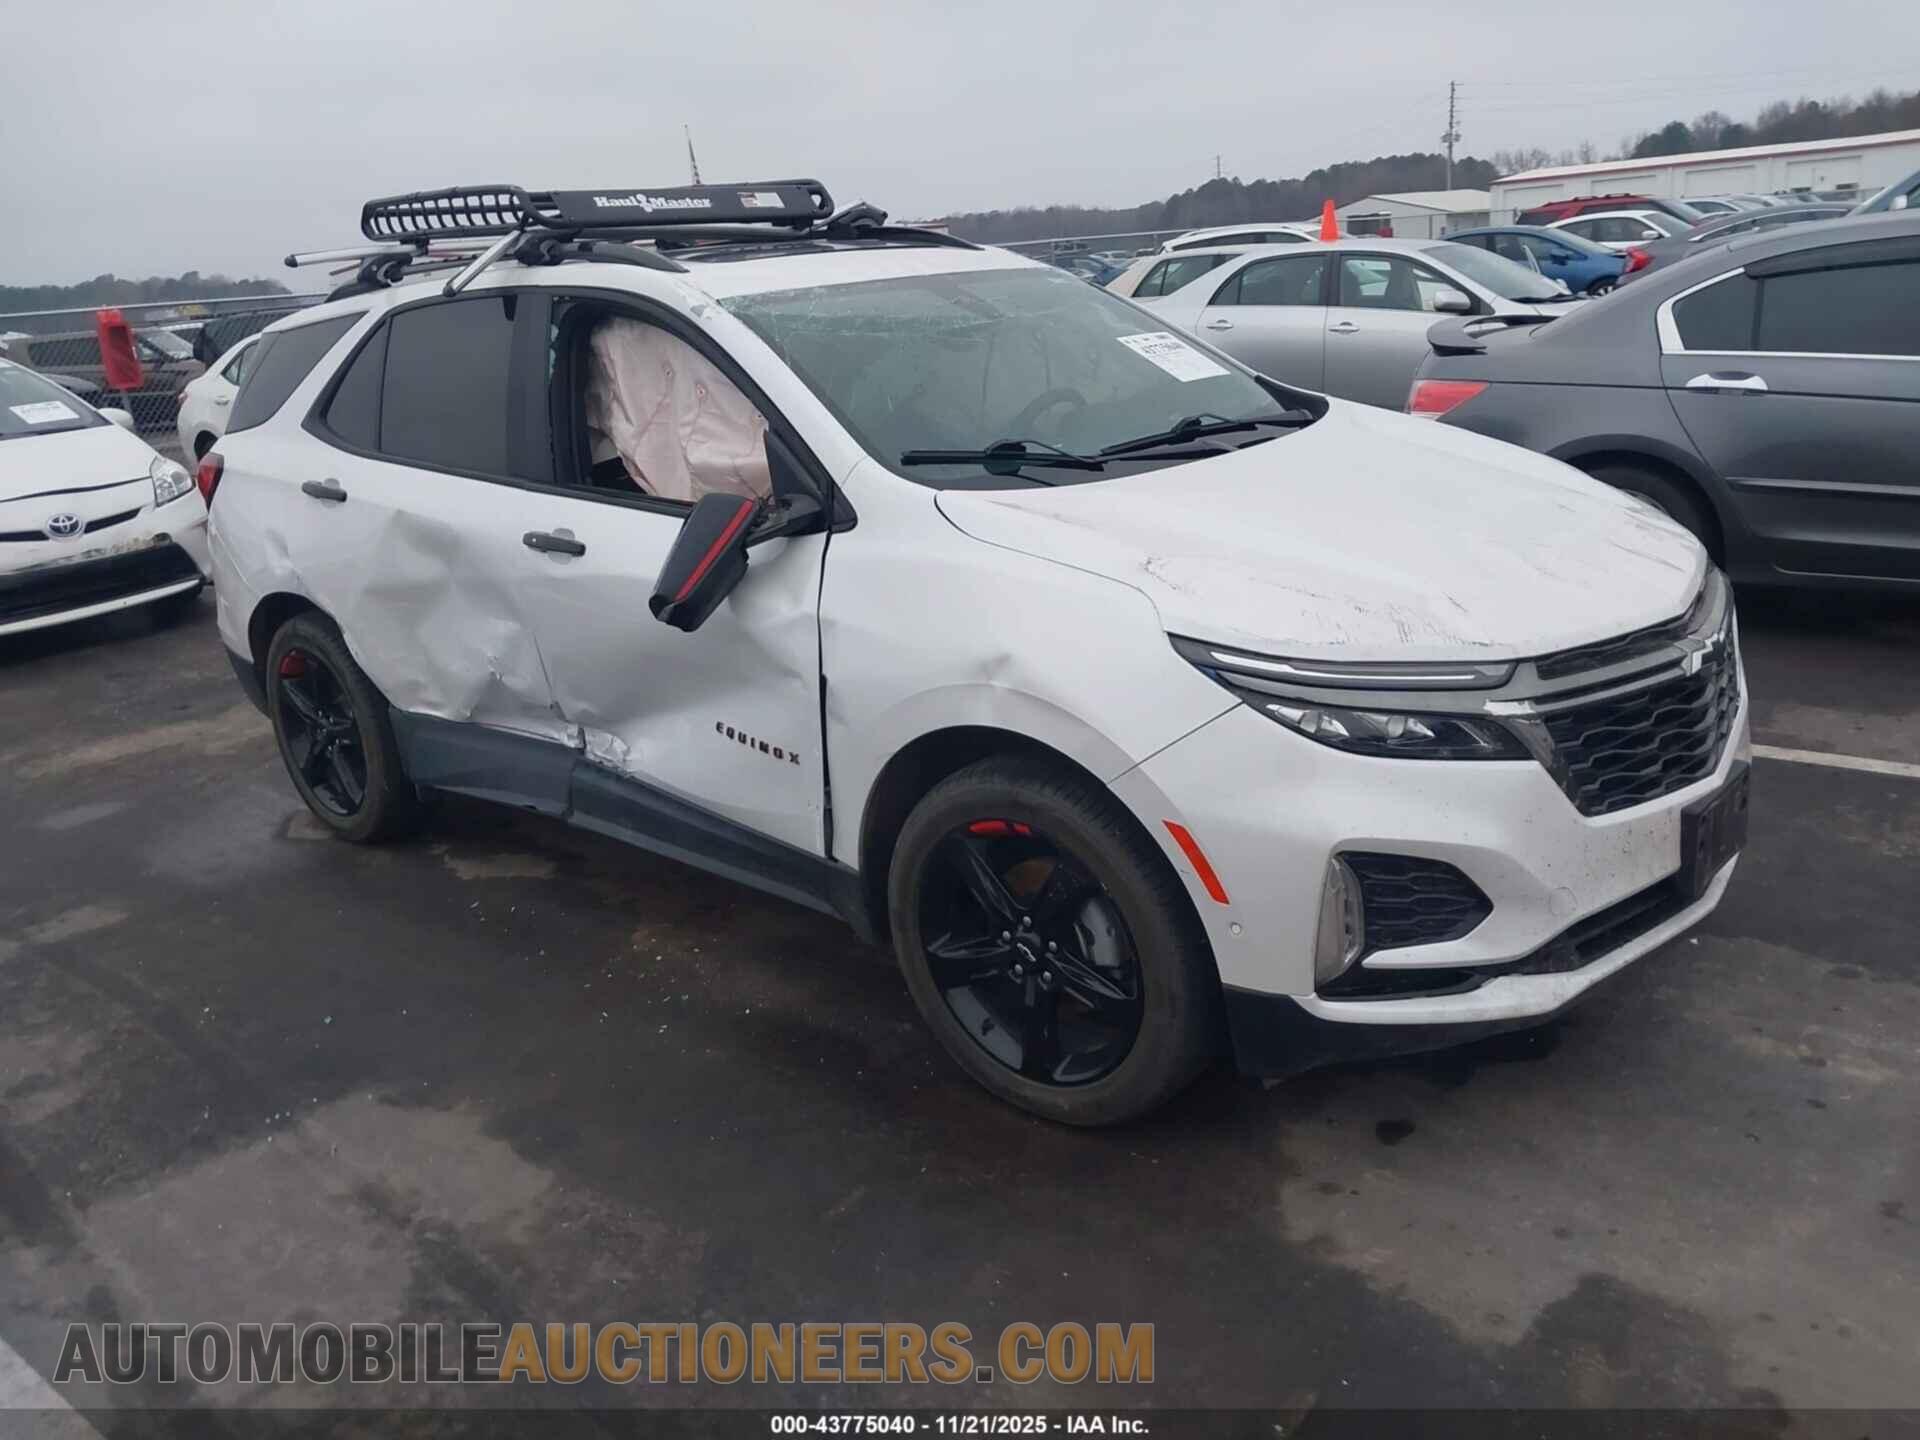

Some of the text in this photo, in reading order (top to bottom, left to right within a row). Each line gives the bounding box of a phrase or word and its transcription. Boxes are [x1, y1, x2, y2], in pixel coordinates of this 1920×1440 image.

[593, 195, 712, 209] Haul Master
[715, 721, 801, 766] EQUINOX
